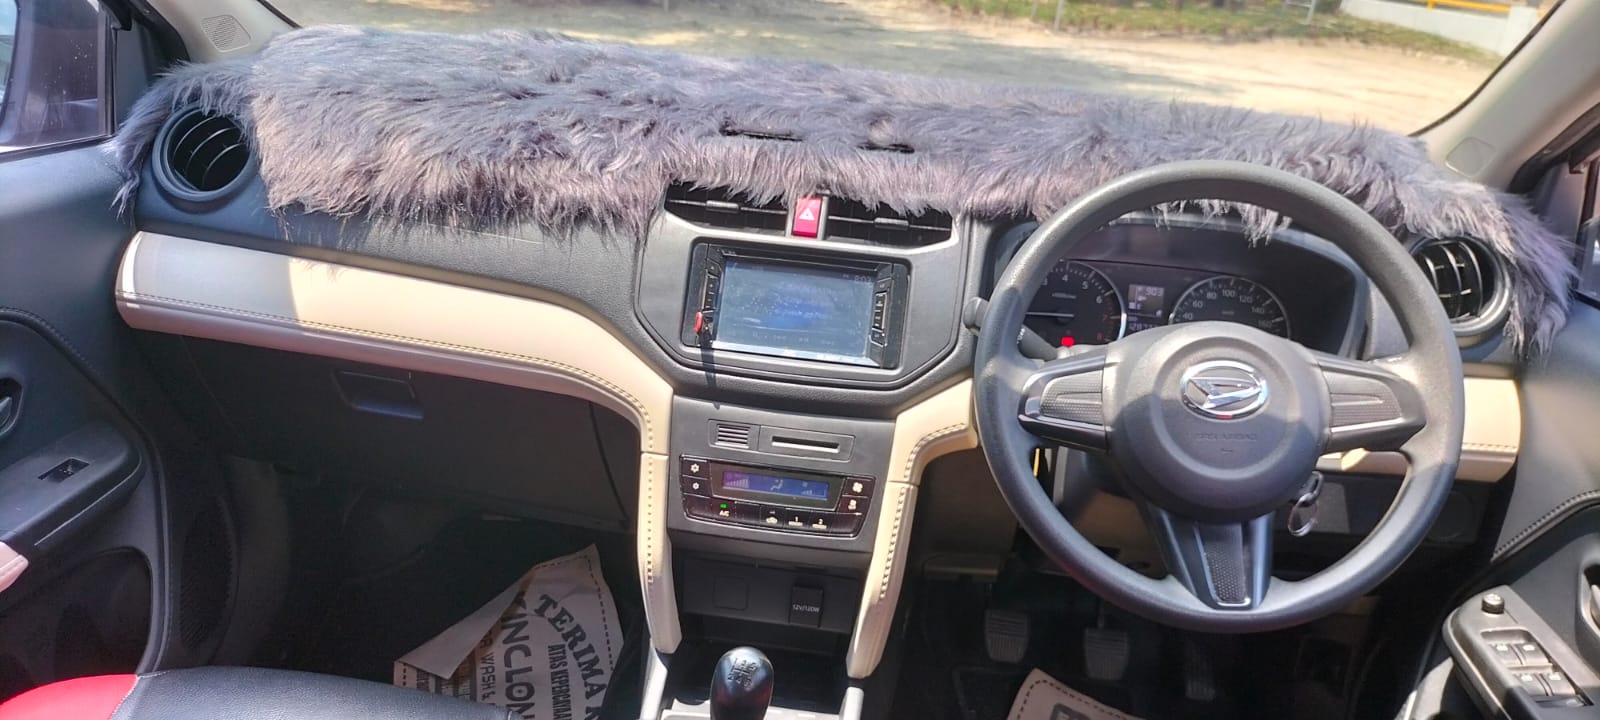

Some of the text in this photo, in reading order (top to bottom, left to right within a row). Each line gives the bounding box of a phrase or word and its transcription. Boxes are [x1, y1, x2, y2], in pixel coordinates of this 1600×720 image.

[1061, 274, 1069, 282] 4
[1081, 281, 1089, 290] 5
[1205, 291, 1217, 300] 80
[1221, 289, 1236, 298] 100
[1096, 295, 1103, 304] 6
[1239, 294, 1253, 303] 120
[1191, 300, 1204, 308] 60
[1251, 306, 1265, 314] 140
[1182, 312, 1193, 320] 40
[534, 594, 608, 700] TERIMA
[548, 644, 568, 670] ATAS
